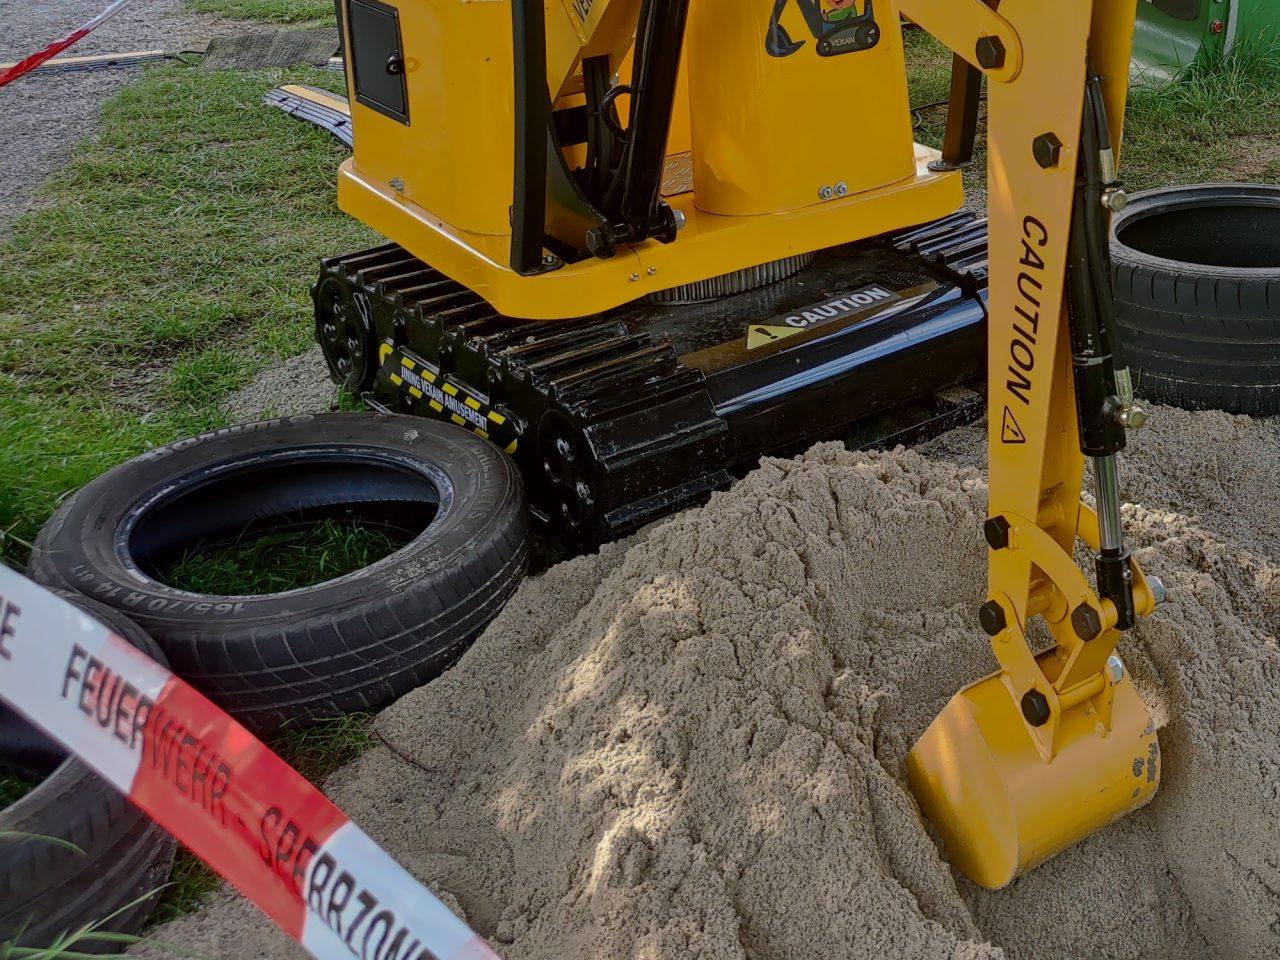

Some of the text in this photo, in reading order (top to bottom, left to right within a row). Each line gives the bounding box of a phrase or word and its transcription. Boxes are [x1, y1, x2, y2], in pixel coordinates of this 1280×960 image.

[831, 37, 855, 47] VEKAIN
[785, 287, 891, 328] CAUTION
[1006, 214, 1048, 406] CAUTION
[421, 378, 444, 404] VEKAIN
[444, 394, 488, 431] AMUSEMENT
